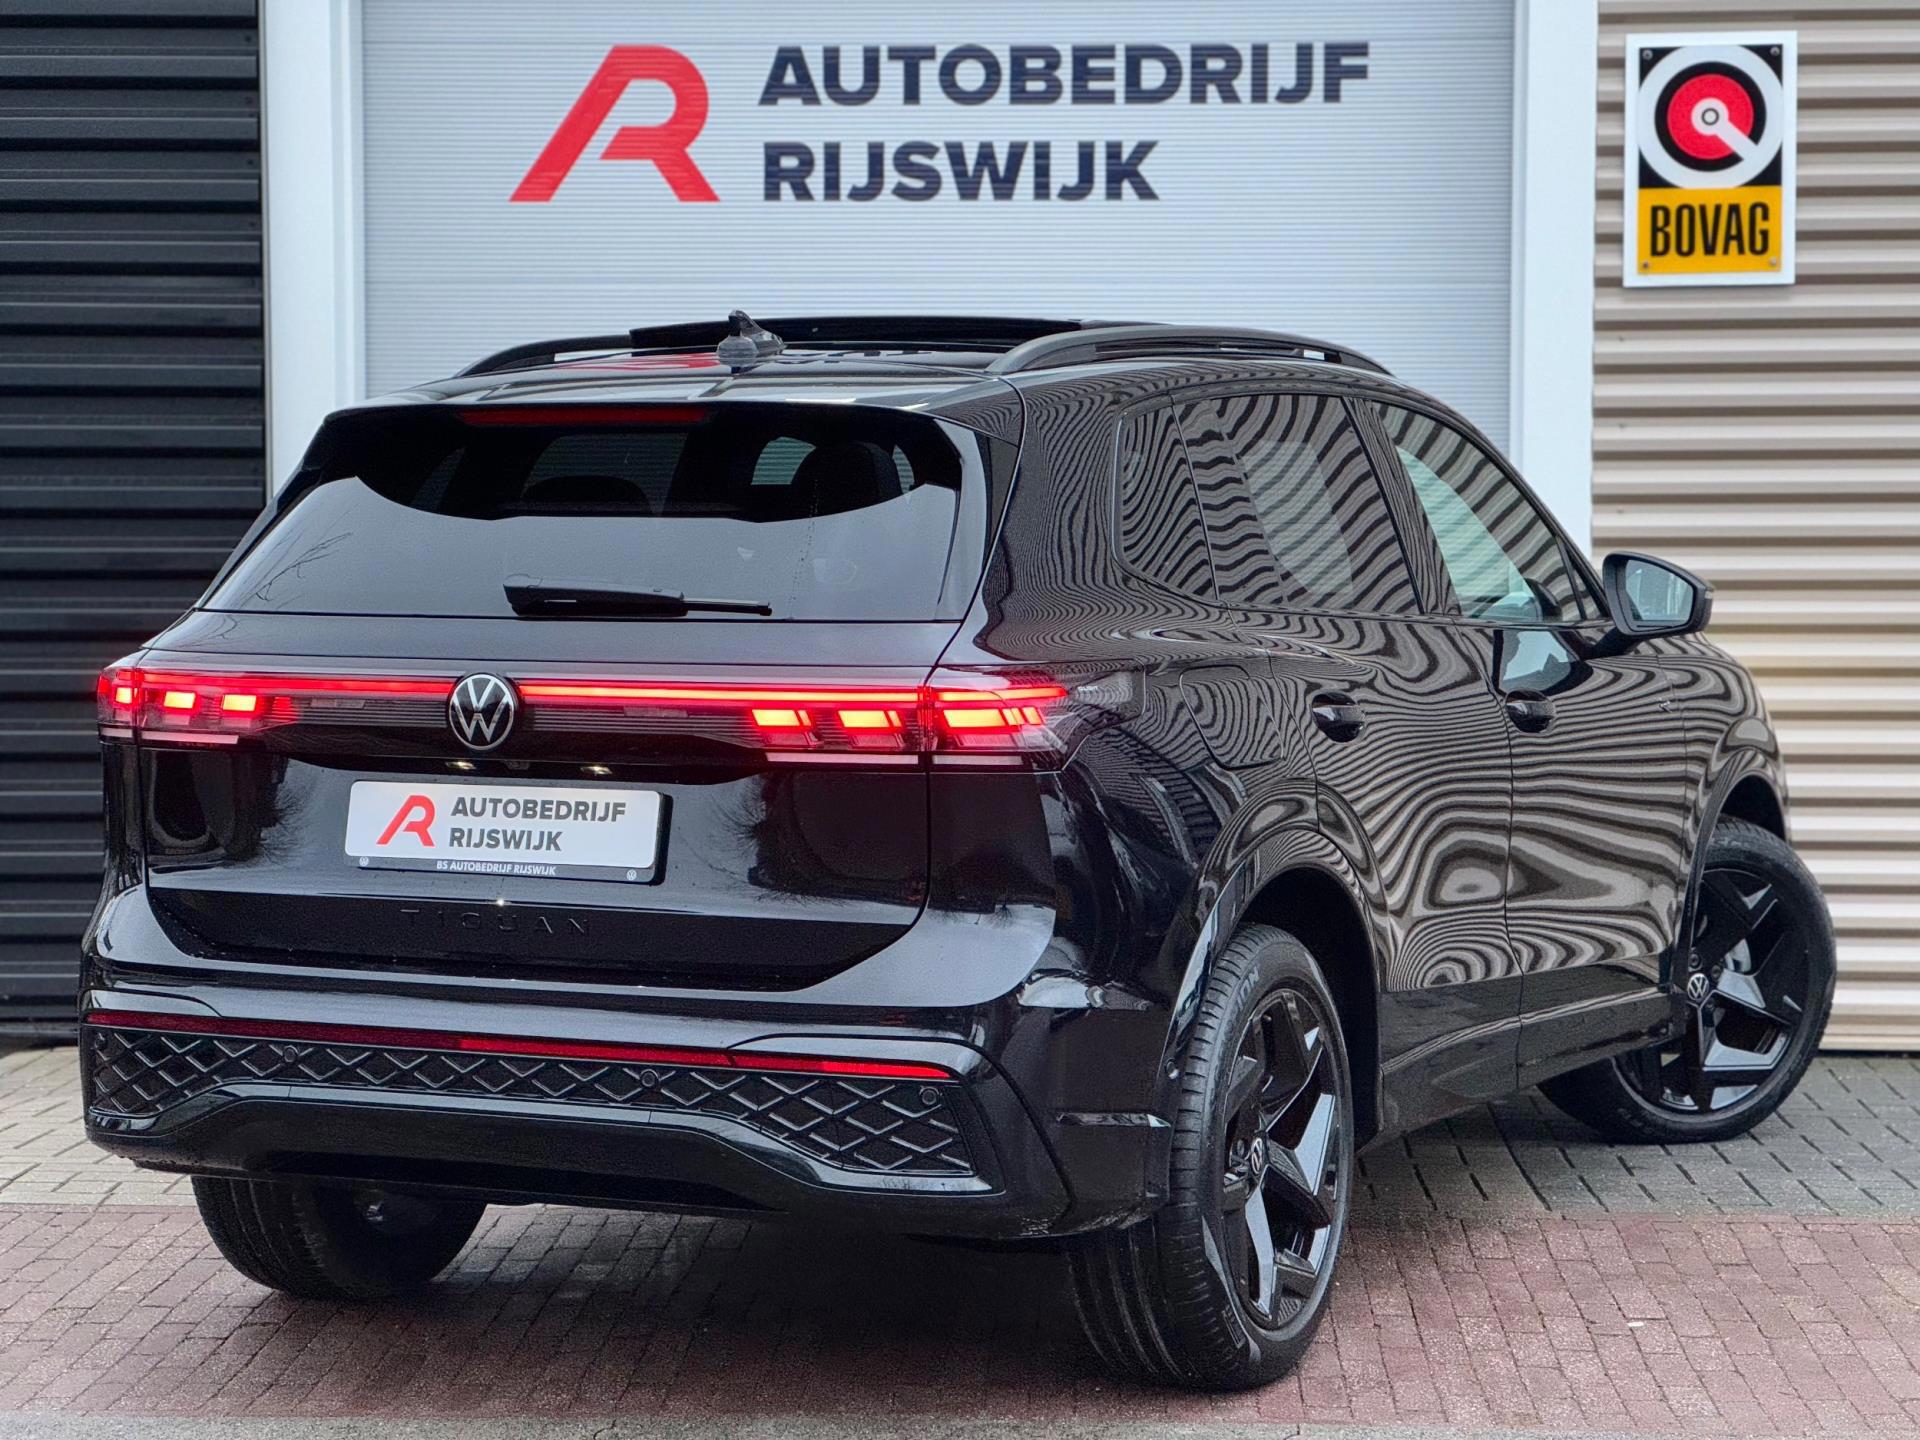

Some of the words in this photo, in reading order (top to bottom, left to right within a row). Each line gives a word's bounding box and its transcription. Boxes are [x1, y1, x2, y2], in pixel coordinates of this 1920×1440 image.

[758, 42, 1370, 106] AUTOBEDRIJF
[763, 141, 1160, 202] RIJSWIJK
[1650, 202, 1770, 257] BOVAG
[450, 796, 627, 823] AUTOBEDRIJF
[448, 827, 563, 851] RIJSWIJK
[436, 861, 448, 871] BS
[450, 861, 512, 874] AUTOBEDRIJF
[513, 864, 556, 876] RIJSWIJK
[400, 908, 590, 935] TIGUAN
